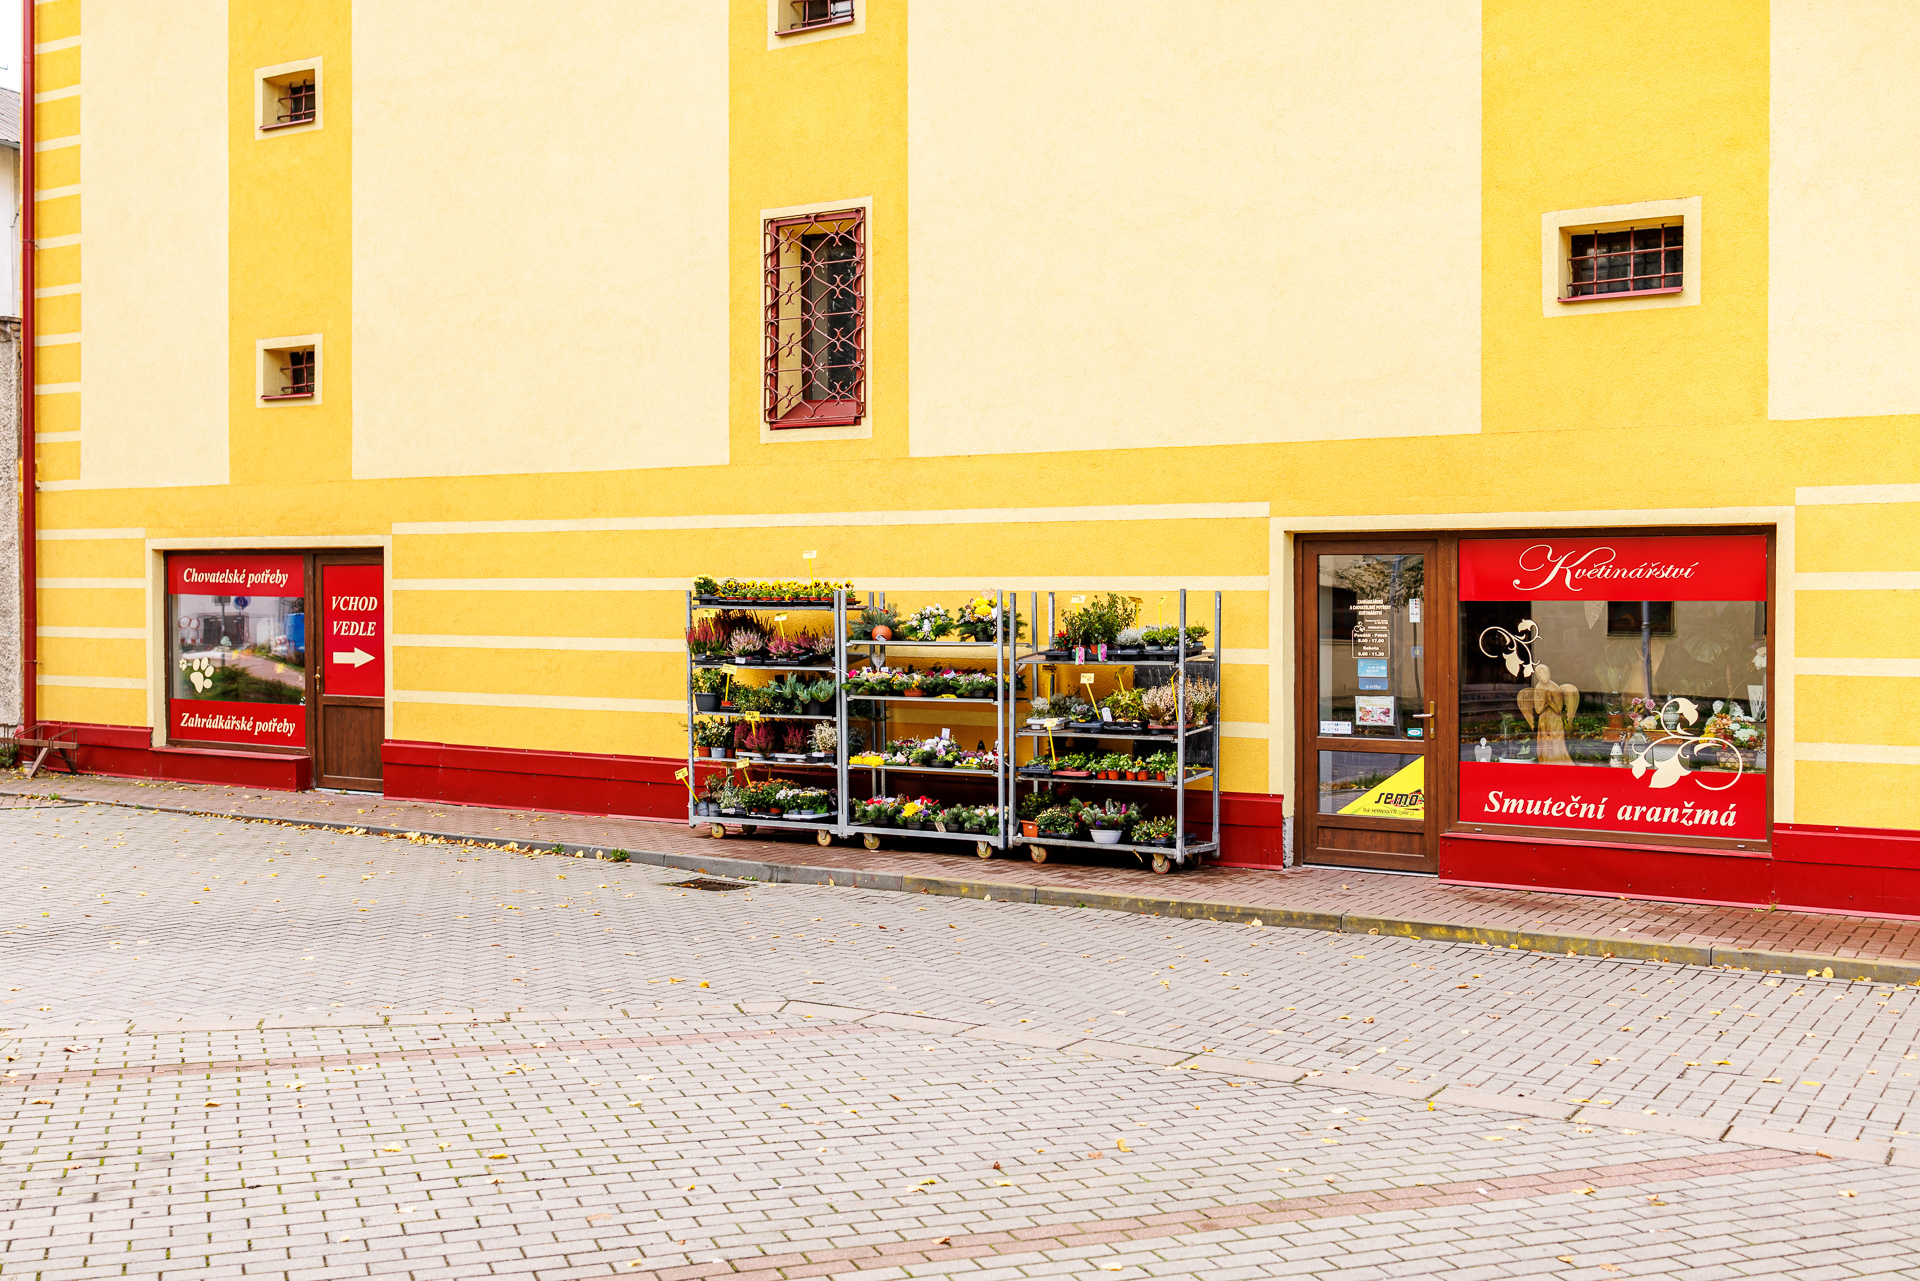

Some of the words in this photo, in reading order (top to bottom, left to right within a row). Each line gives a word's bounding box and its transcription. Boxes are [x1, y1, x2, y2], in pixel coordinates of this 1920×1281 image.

[183, 567, 247, 584] Chovatelské
[247, 569, 288, 588] potřeby
[1513, 544, 1699, 591] Květinářství
[331, 596, 378, 611] VCHOD
[332, 621, 376, 636] VEDLE
[180, 712, 254, 732] Zahrádkářské
[254, 718, 296, 736] potřeby
[1484, 790, 1608, 820] Smuteční
[1616, 801, 1737, 827] aranžmá
